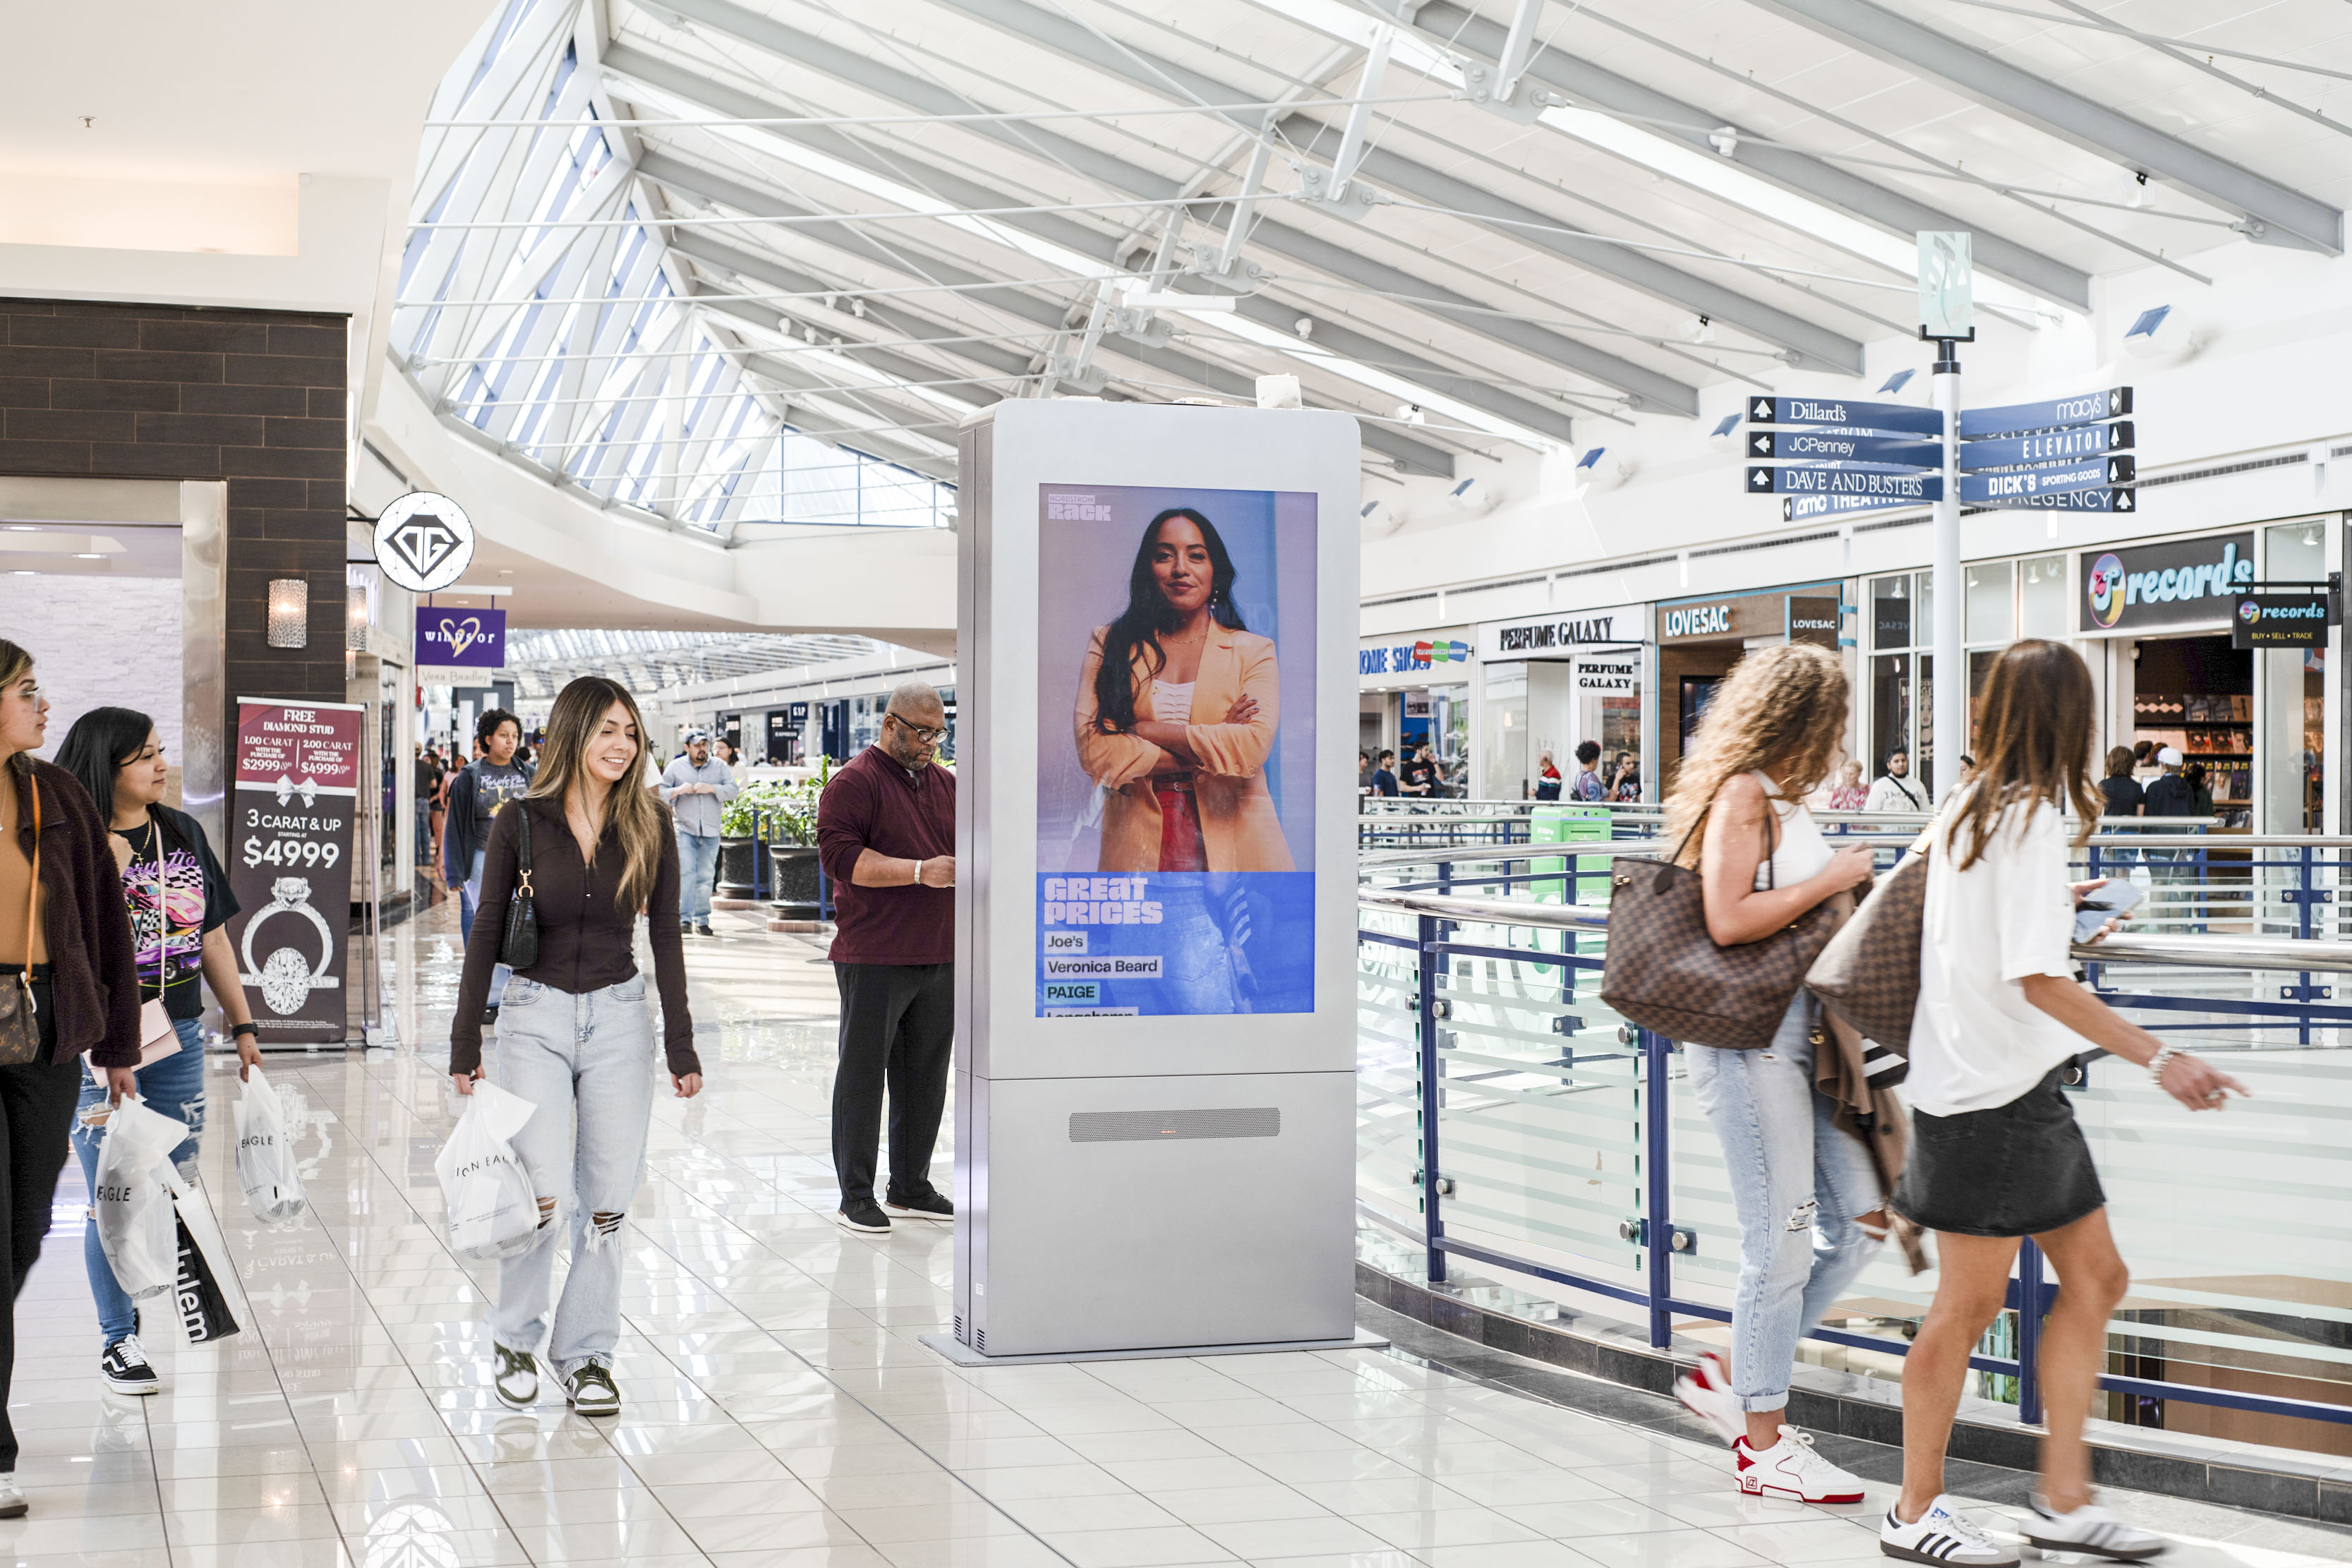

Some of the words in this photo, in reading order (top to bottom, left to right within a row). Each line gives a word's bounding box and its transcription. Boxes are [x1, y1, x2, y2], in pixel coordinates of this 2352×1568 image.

[1790, 401, 1847, 421] Dillard's
[1789, 437, 1855, 457] JCPenney
[2022, 430, 2101, 459] ELEVATOR
[1785, 471, 1827, 490] DAVE
[1831, 473, 1866, 493] AND
[1868, 474, 1923, 496] BUSTER'S
[1989, 474, 2037, 495] DICK'S
[2042, 472, 2077, 486] SPORTING
[2077, 469, 2101, 481] GOODS
[2125, 543, 2254, 605] records
[2262, 602, 2325, 618] records
[1665, 605, 1731, 637] LOVESAC
[1792, 620, 1835, 629] LOVESAC
[1500, 625, 1555, 651] PERFUME
[1557, 616, 1614, 645] GALAXY
[1578, 663, 1634, 675] PERFUME
[1579, 677, 1632, 689] GALAXY
[284, 708, 315, 723] FREE
[263, 721, 307, 733] DIAMOND
[309, 725, 334, 735] STUD
[263, 737, 294, 747] CARAT
[322, 741, 354, 751] CARAT
[242, 759, 280, 771] $2999
[301, 761, 338, 775] $4999
[247, 809, 259, 828] 3
[261, 814, 308, 830] CARAT
[309, 817, 320, 831] &
[322, 819, 342, 831] UP
[243, 835, 340, 869] $4999
[1044, 901, 1164, 924] PRICES
[1048, 935, 1084, 948] Joe's
[1048, 960, 1111, 973] Veronica
[1115, 960, 1158, 972] Beard
[1047, 986, 1095, 999] PAIGE
[97, 1185, 131, 1202] EGLE
